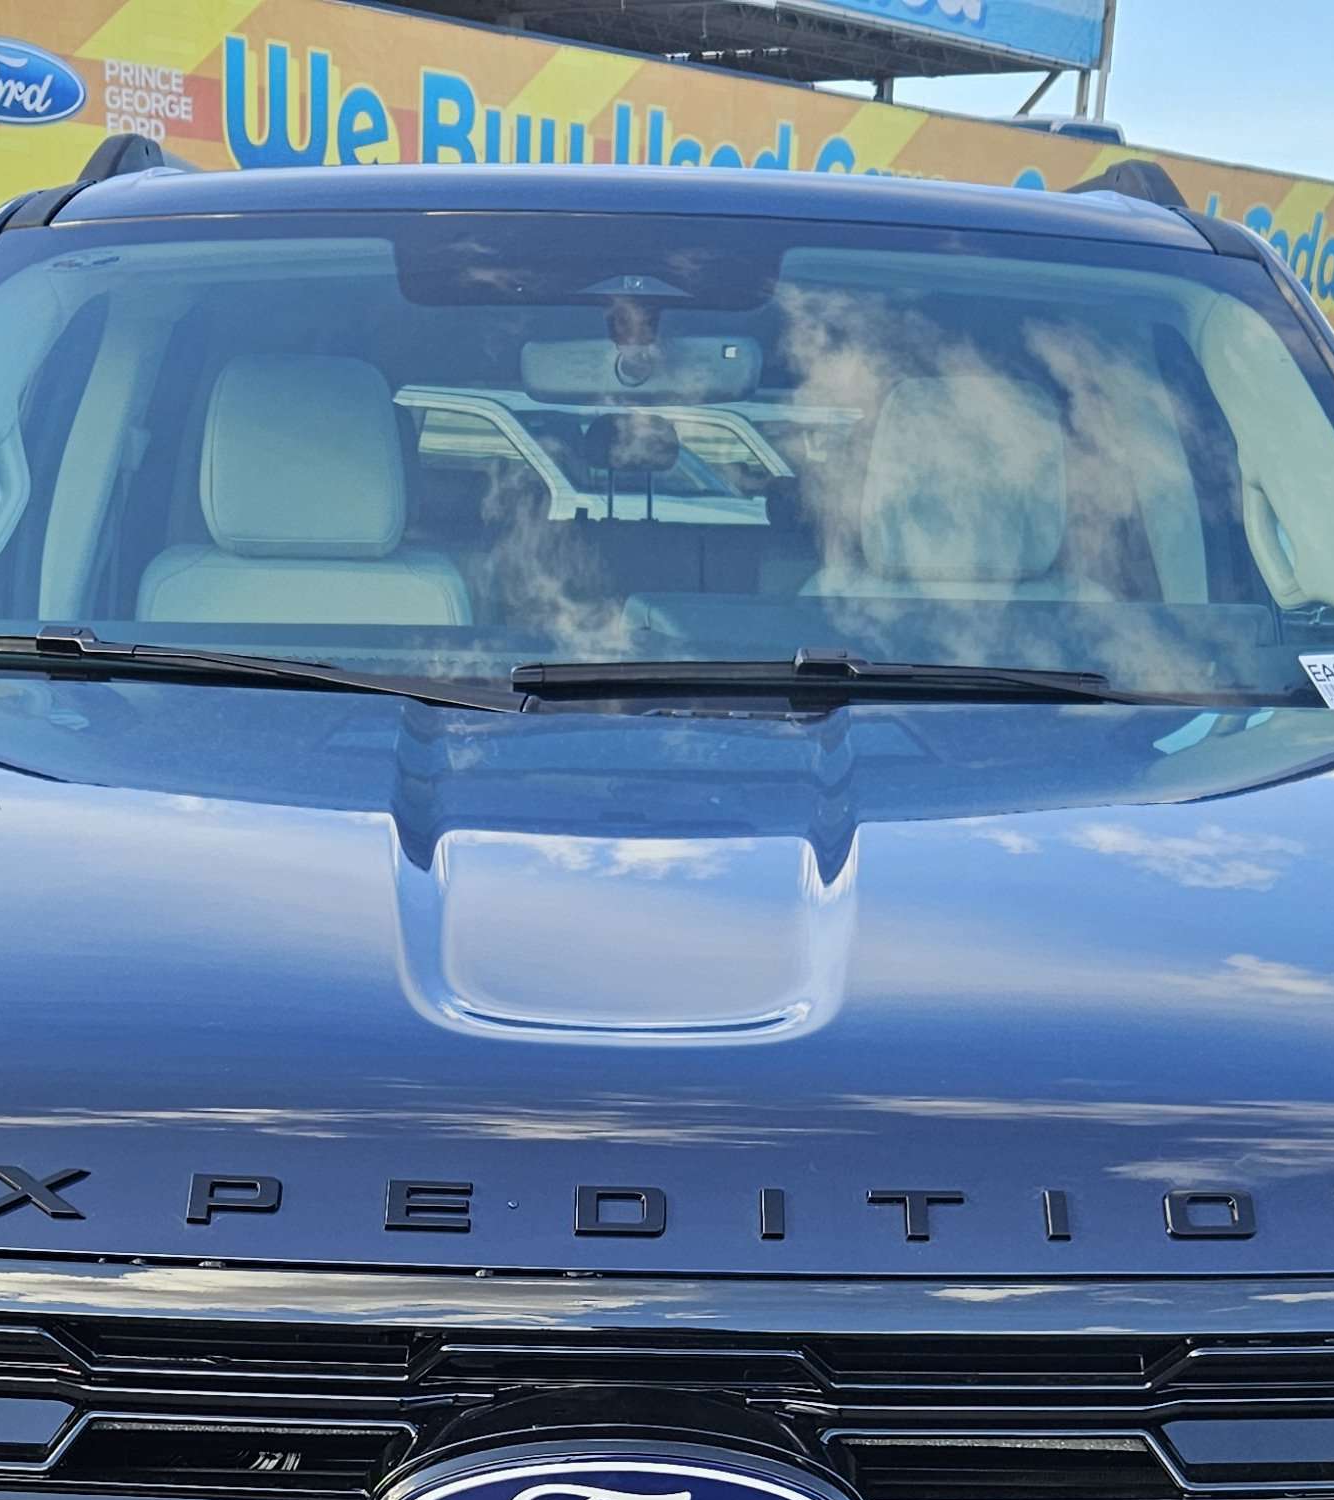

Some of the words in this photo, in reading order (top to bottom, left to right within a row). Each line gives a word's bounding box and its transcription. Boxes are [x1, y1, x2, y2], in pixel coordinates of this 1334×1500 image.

[105, 58, 184, 94] PRINCE
[105, 85, 193, 123] GEORGE
[223, 34, 389, 169] We
[105, 111, 166, 144] FORD
